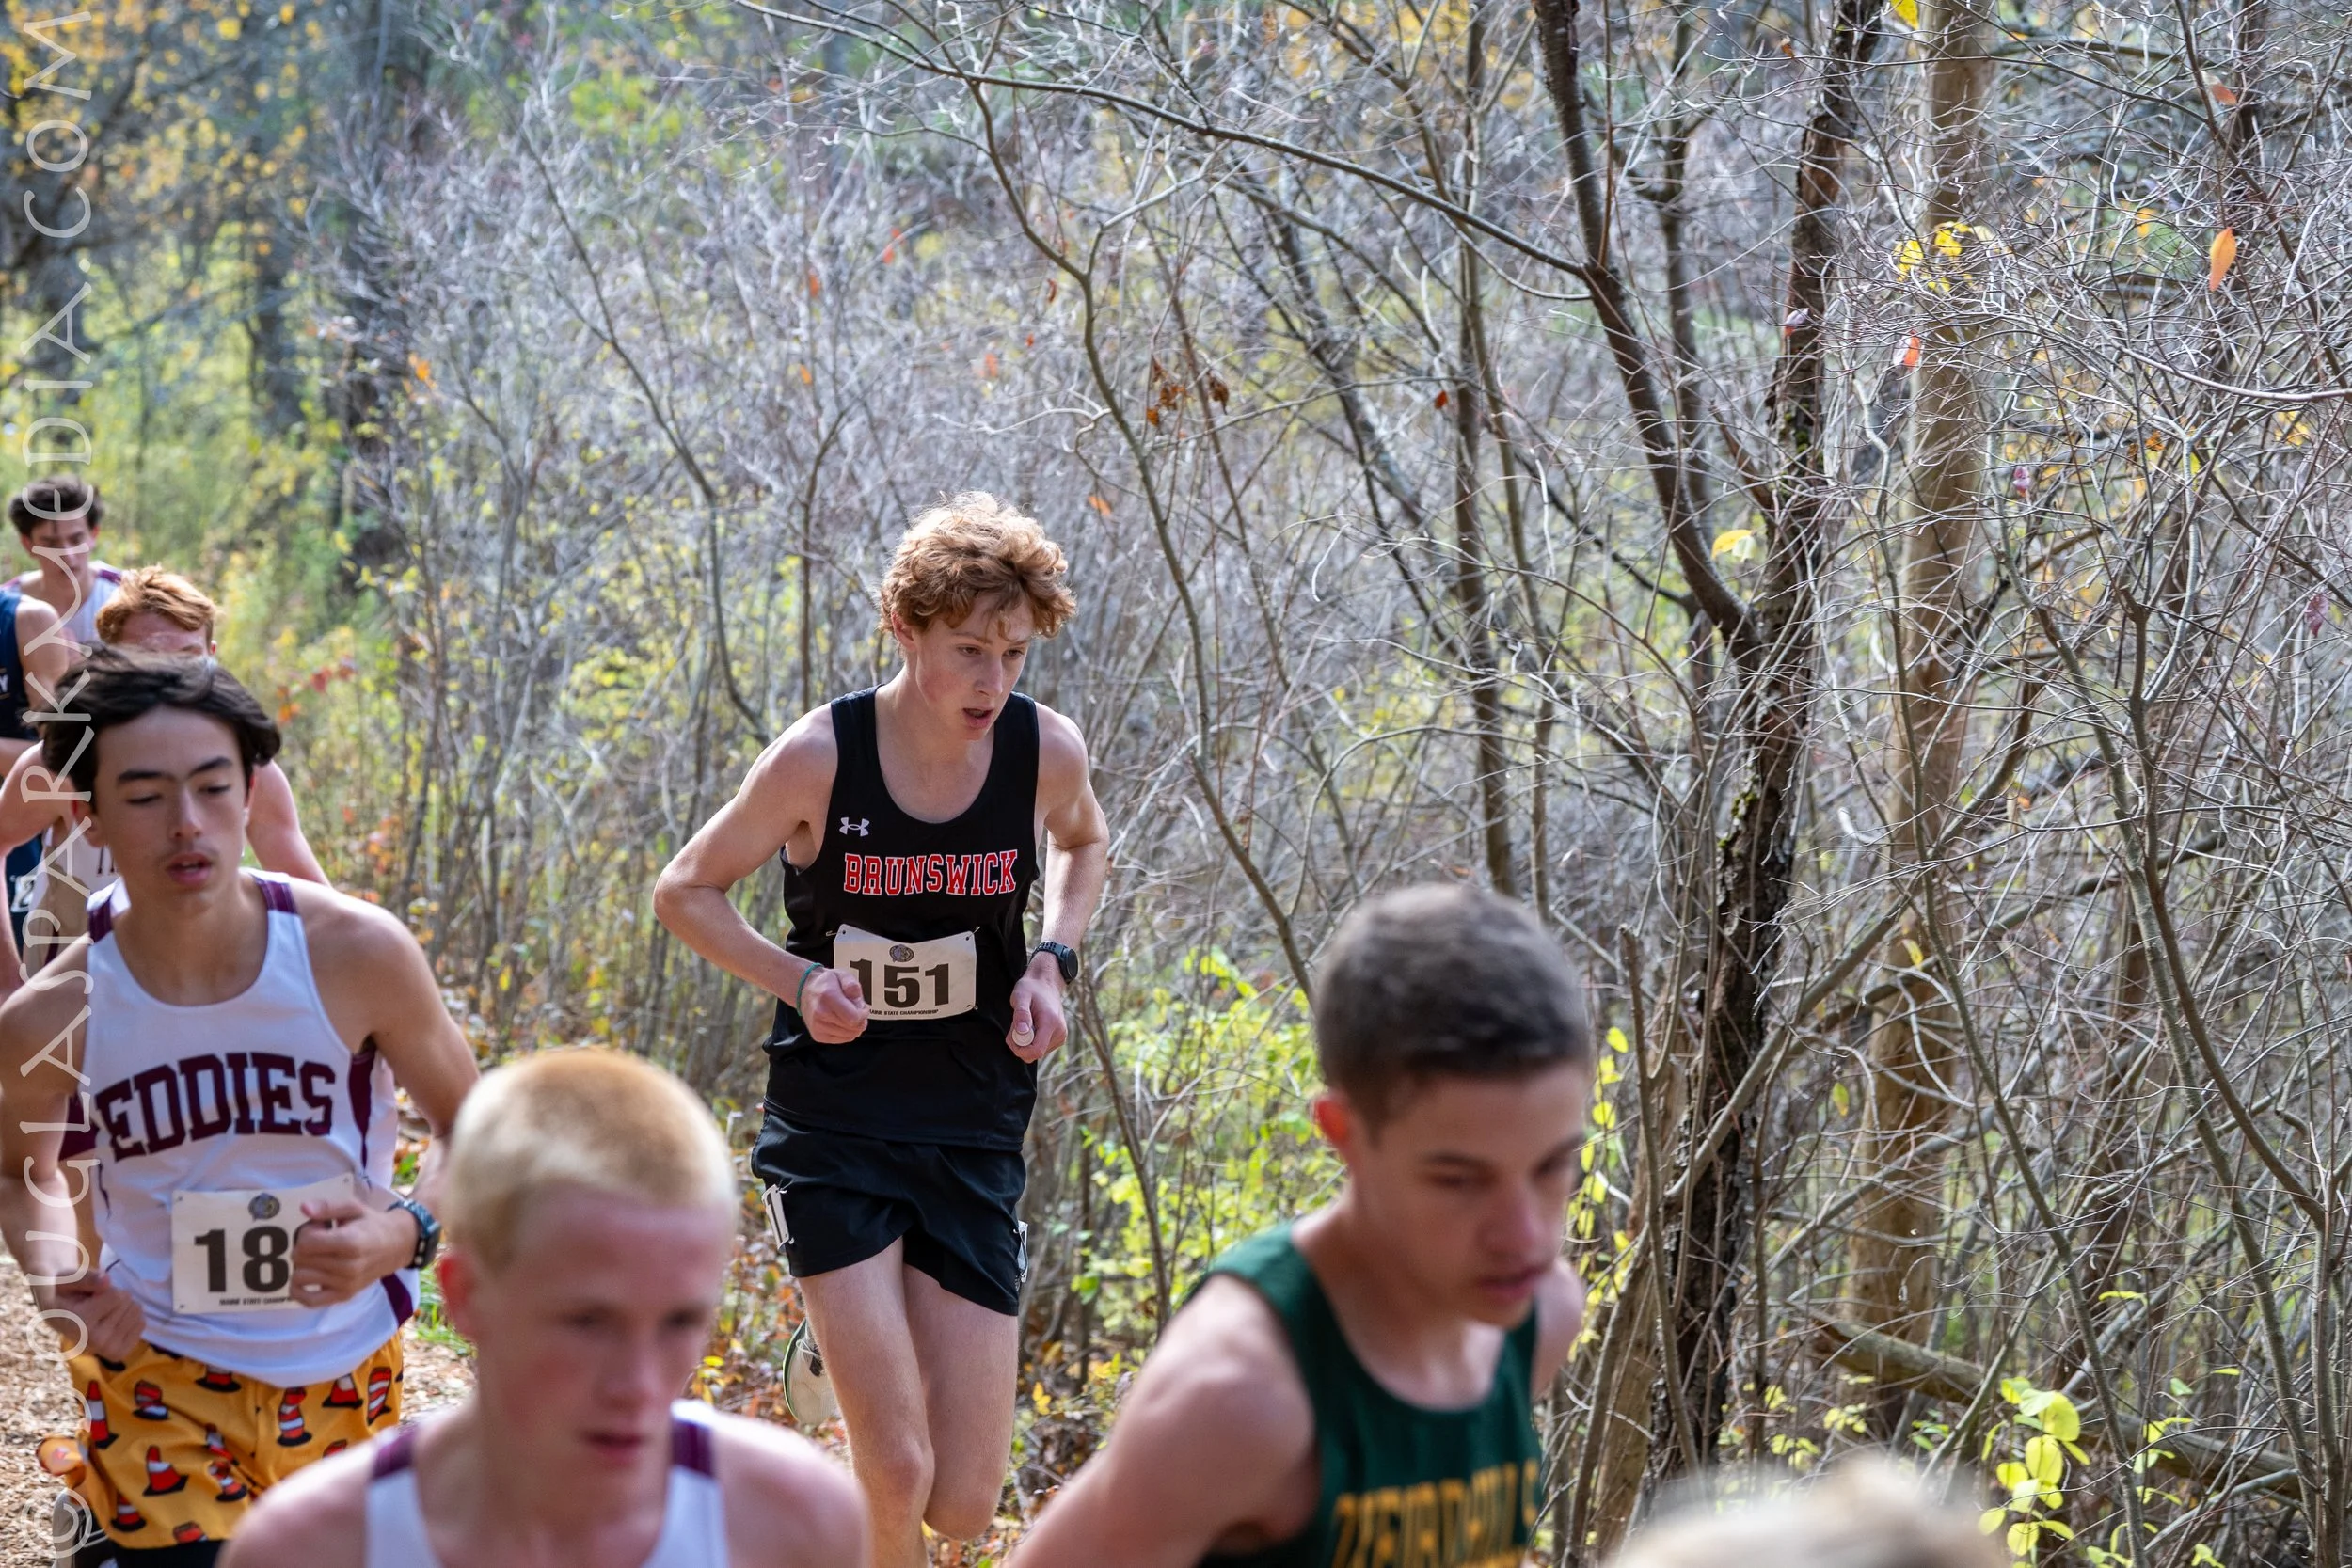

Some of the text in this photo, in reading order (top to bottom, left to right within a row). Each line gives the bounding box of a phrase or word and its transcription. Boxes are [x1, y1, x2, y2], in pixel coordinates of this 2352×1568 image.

[844, 849, 1018, 895] BRUNSWICK
[850, 958, 949, 1008] 151
[94, 1052, 336, 1163] EDDIES
[194, 1219, 334, 1293] 18
